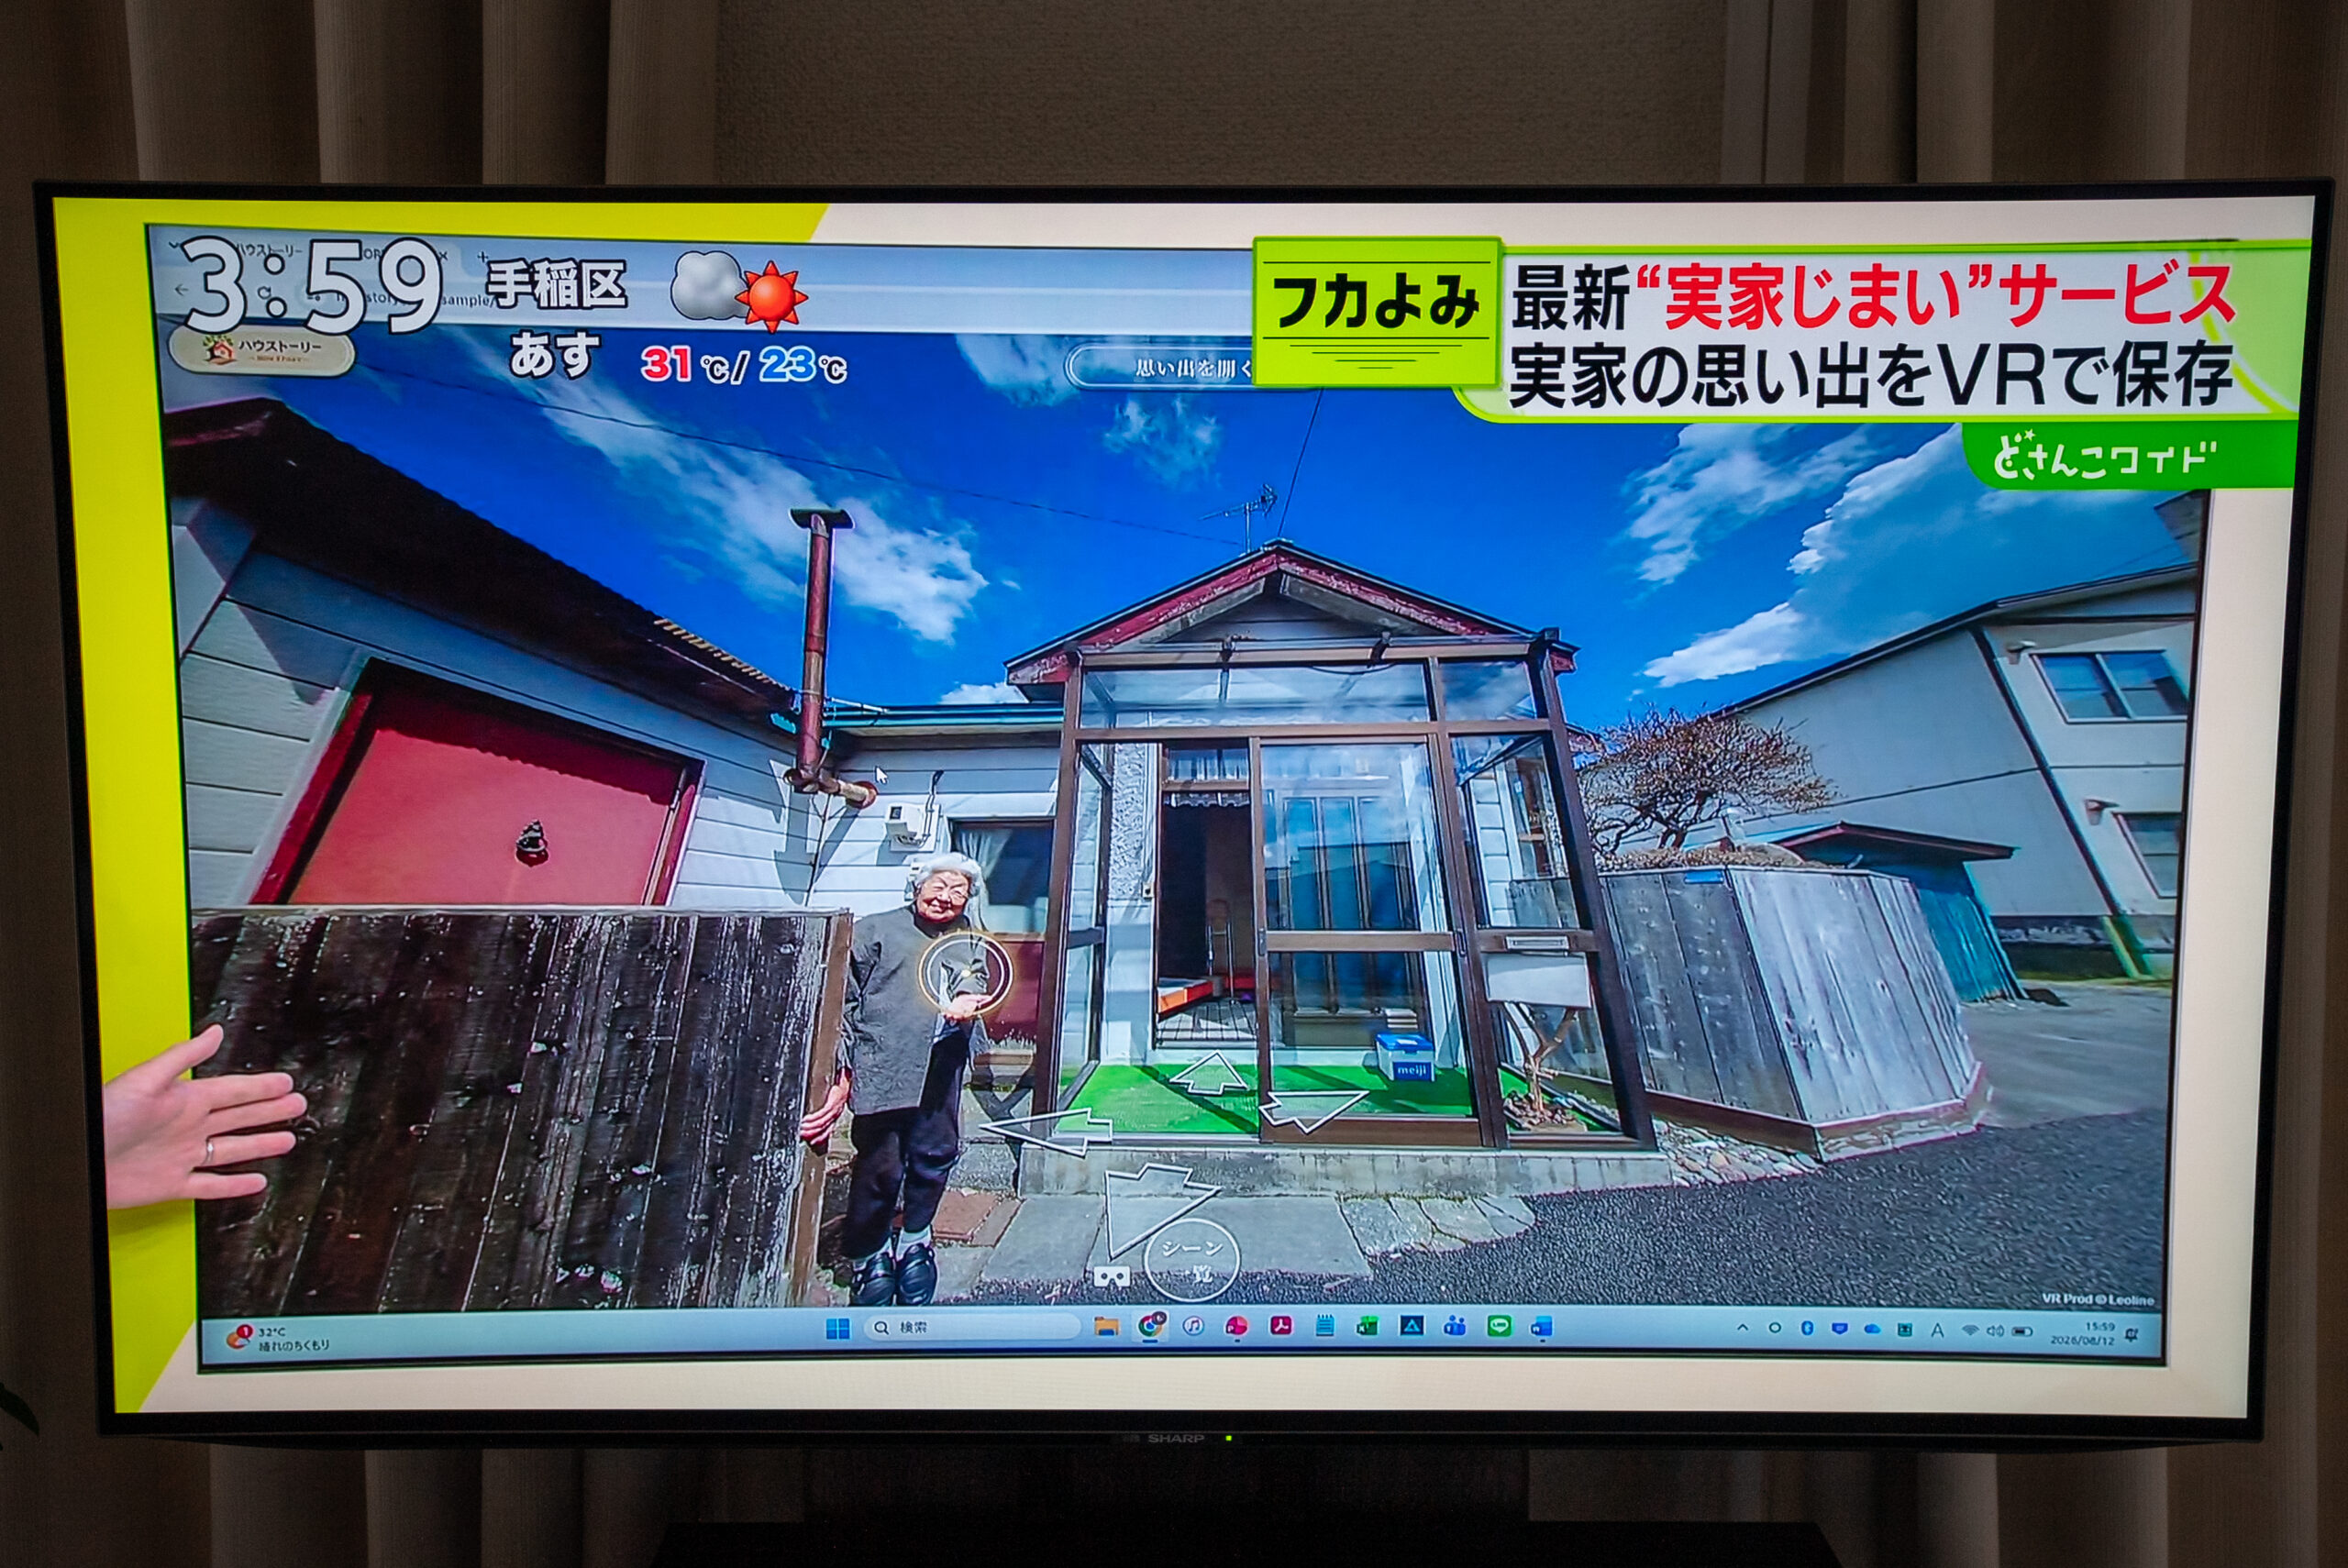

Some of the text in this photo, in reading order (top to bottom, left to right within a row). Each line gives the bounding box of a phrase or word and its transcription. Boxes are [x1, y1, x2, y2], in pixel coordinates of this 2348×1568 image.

[183, 235, 443, 335] 3:59
[486, 259, 627, 309] 手稲区
[1273, 272, 1479, 328] フカよみ
[239, 340, 321, 353] ハウストーリー
[510, 330, 601, 379] あす
[1510, 340, 2234, 409] 実家の思い出をVRで保存
[1994, 429, 2217, 480] どさんこワイド
[1397, 1065, 1427, 1077] meiji
[1162, 1241, 1224, 1257] シーン
[2042, 1293, 2061, 1303] VR
[2063, 1294, 2093, 1305] Prod
[2109, 1294, 2155, 1306] Leoline
[1148, 1434, 1205, 1443] SHARP
